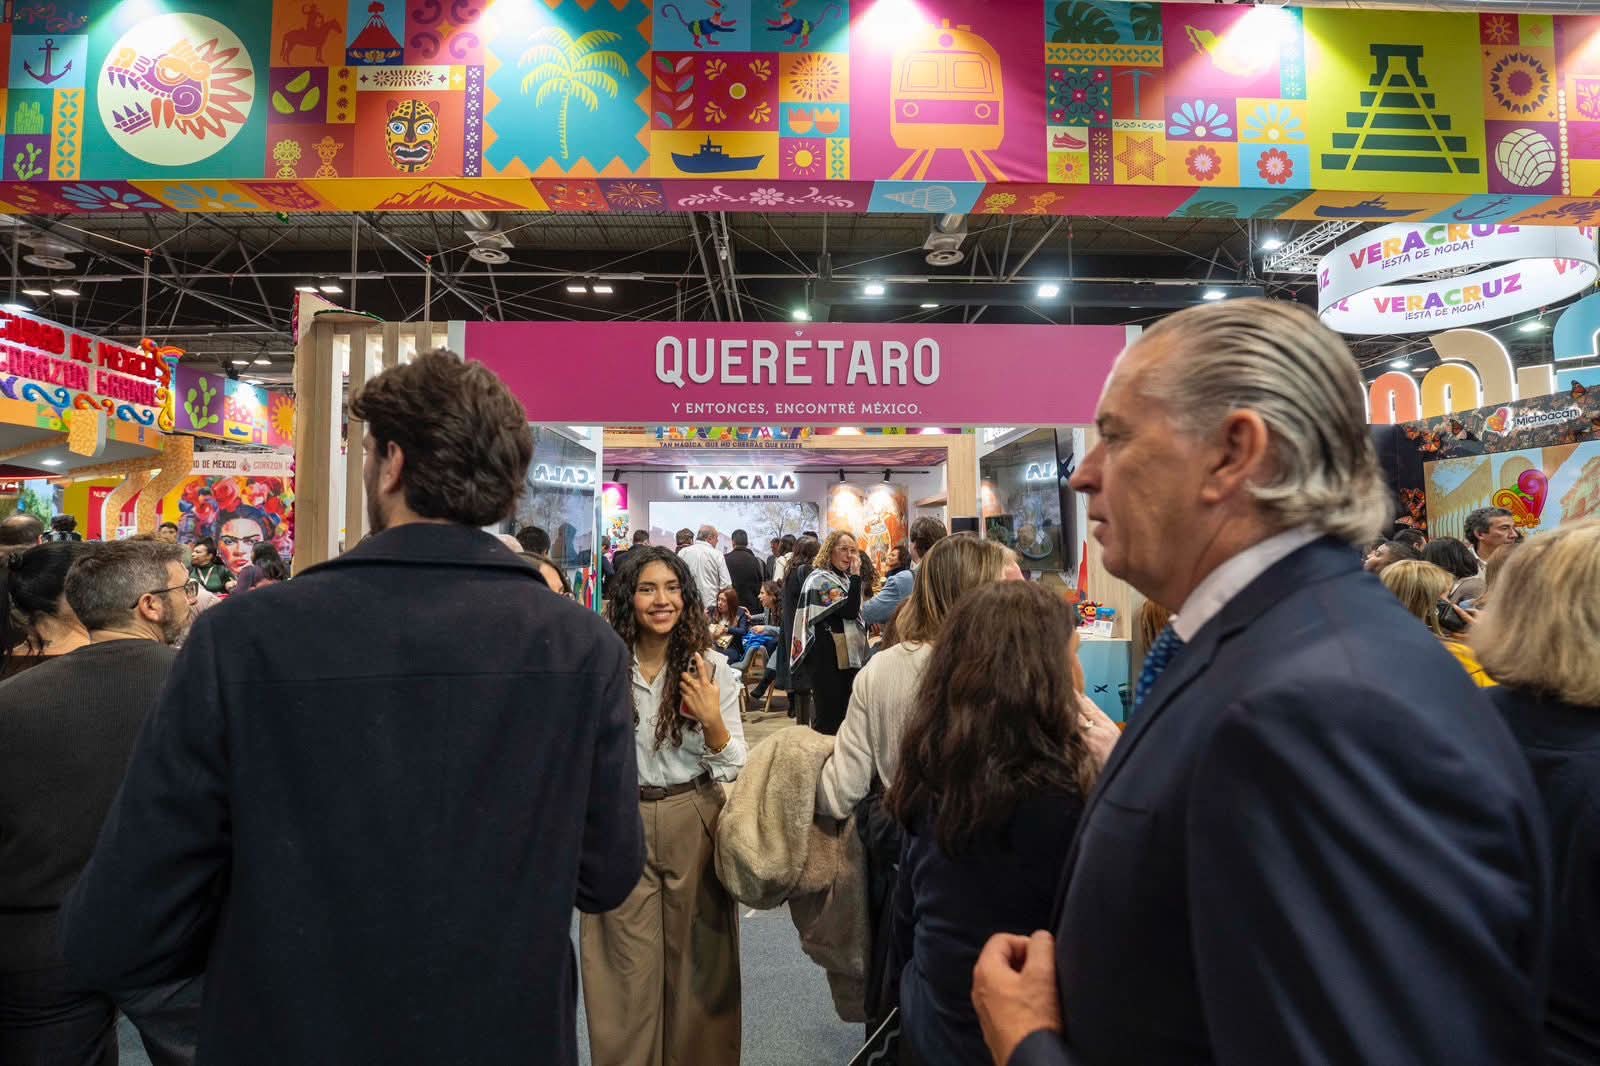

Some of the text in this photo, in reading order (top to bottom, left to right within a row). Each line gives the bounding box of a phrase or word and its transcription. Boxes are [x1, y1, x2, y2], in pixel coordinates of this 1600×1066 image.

[1415, 248, 1430, 259] DE
[1434, 240, 1474, 256] MODA!
[1373, 272, 1522, 314] VERACRUZ
[1435, 307, 1449, 317] DE
[1451, 301, 1486, 315] MODA!
[655, 330, 941, 389] QUERÉTARO
[671, 402, 923, 416] Y ENTONCES, ENCONTRÉ MÉXICO.
[202, 460, 211, 469] DE
[675, 474, 795, 491] TLAXCALA
